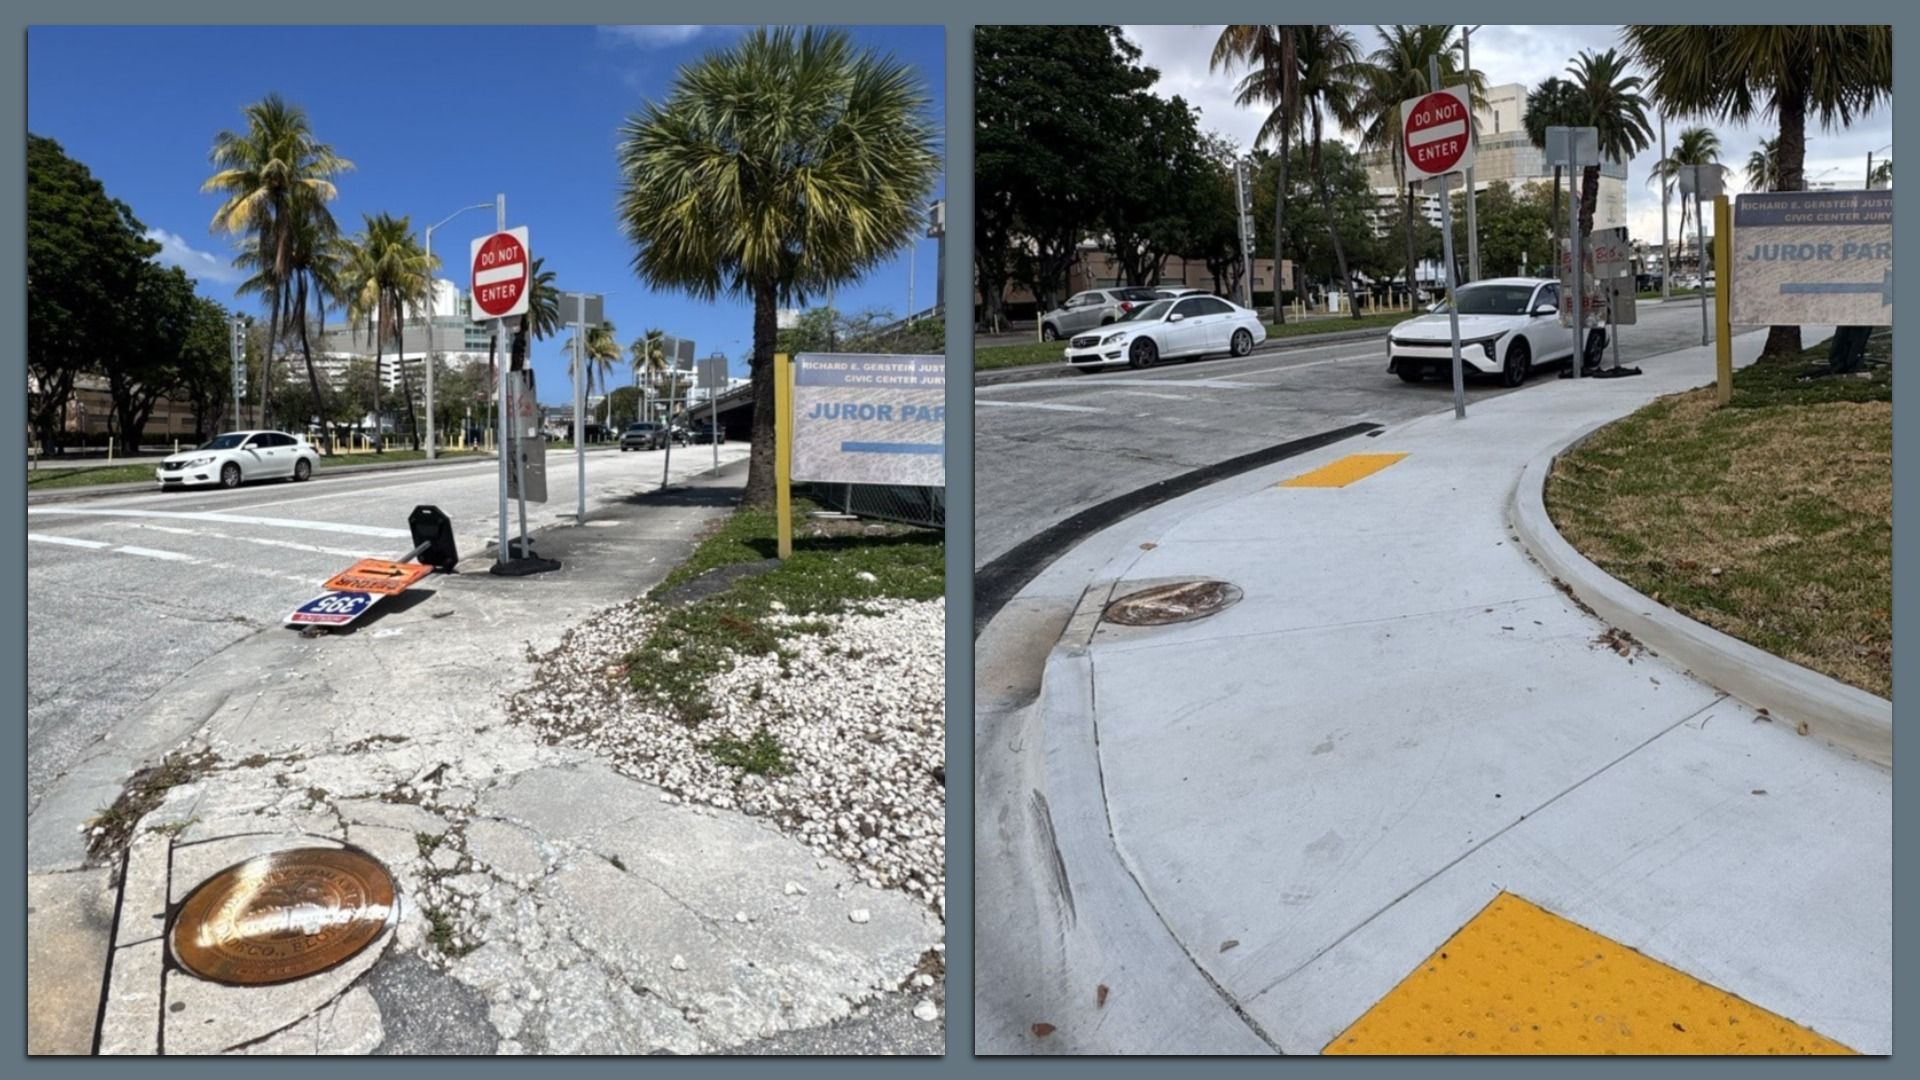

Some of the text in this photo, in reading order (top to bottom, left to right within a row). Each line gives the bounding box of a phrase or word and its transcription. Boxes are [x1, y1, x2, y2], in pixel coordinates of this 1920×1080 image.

[1415, 104, 1458, 126] DO NOT
[1418, 141, 1458, 161] ENTER
[1742, 200, 1787, 210] RICHARD
[1804, 199, 1857, 209] GERSTEIN
[1784, 212, 1892, 222] CIVIC CENTER JURY
[482, 245, 519, 266] DO NOT
[1747, 243, 1833, 261] JUROR
[482, 284, 516, 302] ENTER
[801, 362, 848, 370] RICHARD
[863, 363, 916, 372] GERSTEIN
[844, 375, 872, 383] CIVIC
[875, 375, 917, 384] CENTER
[808, 402, 892, 421] JUROR
[311, 596, 365, 613] 395
